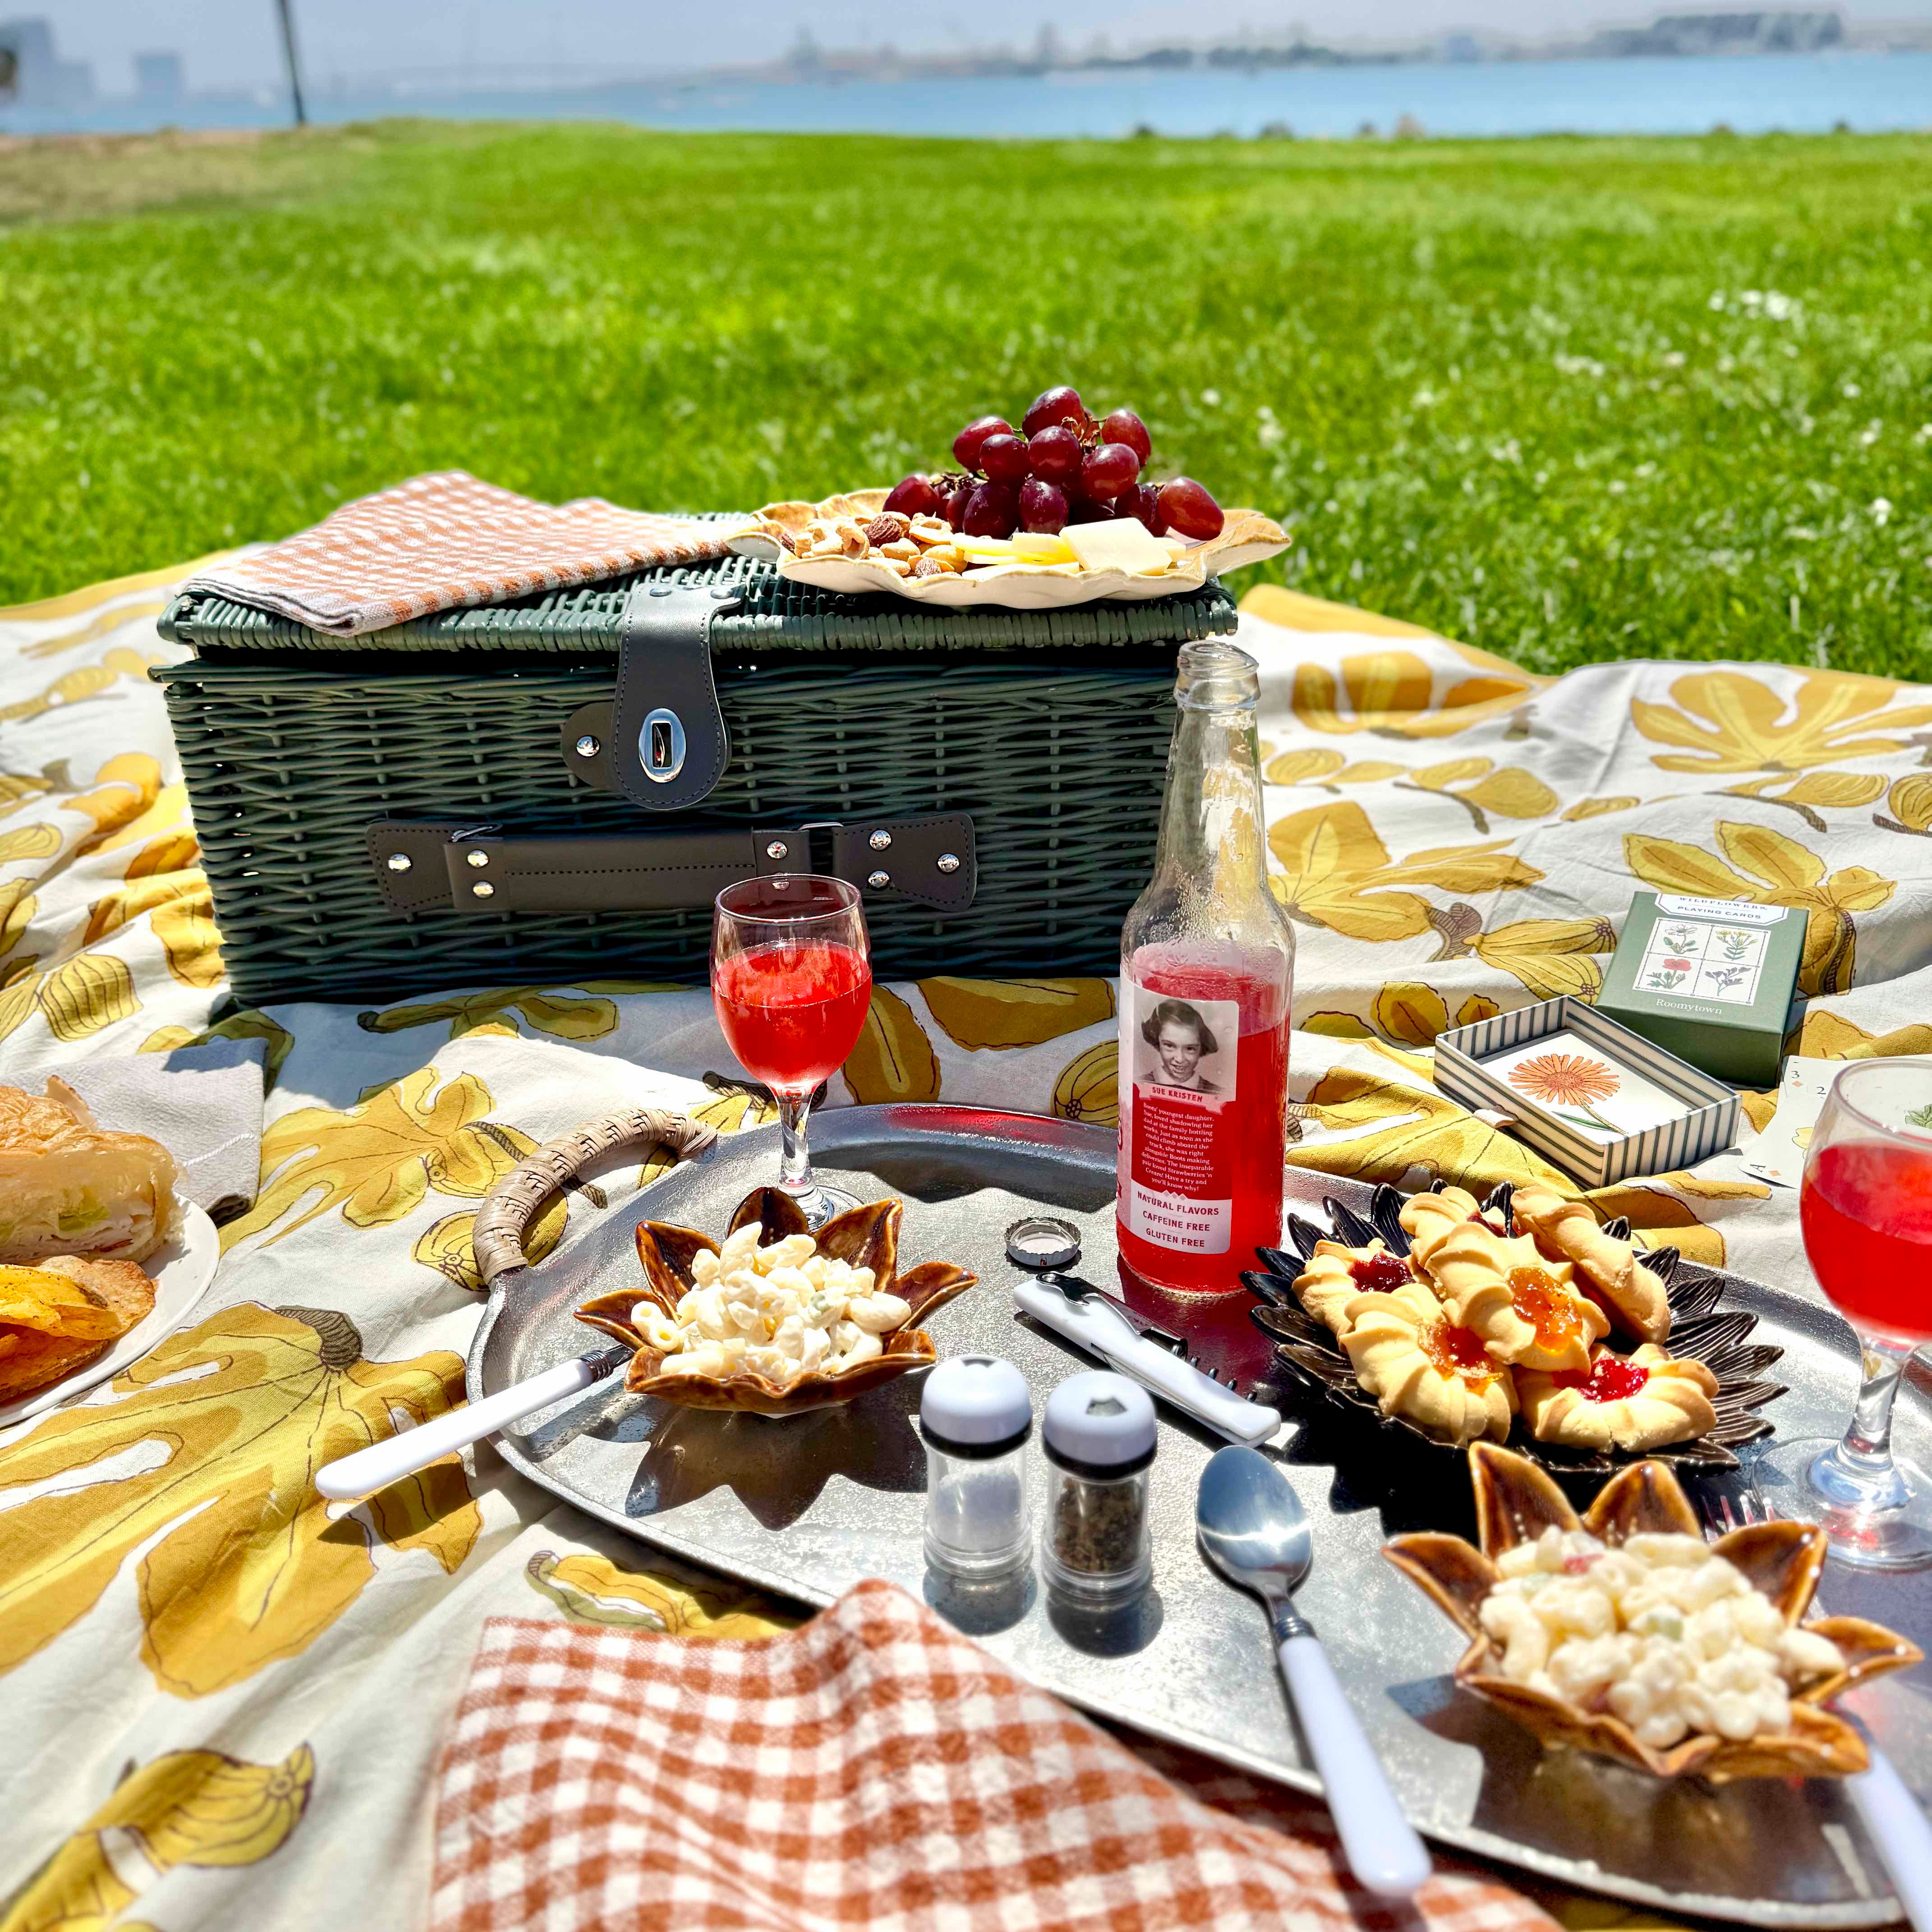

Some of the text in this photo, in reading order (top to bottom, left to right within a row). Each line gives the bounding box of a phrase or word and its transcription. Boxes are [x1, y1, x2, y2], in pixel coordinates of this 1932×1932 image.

[1678, 906, 1761, 919] PLAYING CARDS
[1656, 998, 1721, 1014] Roomytown
[1168, 1090, 1202, 1102] KRISTEN
[1817, 1086, 1826, 1095] 2
[1159, 1109, 1183, 1118] youngest
[1155, 1113, 1168, 1122] loved
[1170, 1119, 1201, 1128] shadowing
[1169, 1125, 1187, 1134] family
[1145, 1133, 1159, 1141] could
[1145, 1146, 1168, 1157] alongside
[1153, 1163, 1166, 1171] loved
[1168, 1168, 1205, 1178] Strawberries
[1750, 1164, 1766, 1172] A
[1138, 1191, 1219, 1215] NATURAL FLAVORS
[1143, 1211, 1210, 1231] CAFFEINE FREE
[1146, 1228, 1205, 1247] GLUTEN FREE
